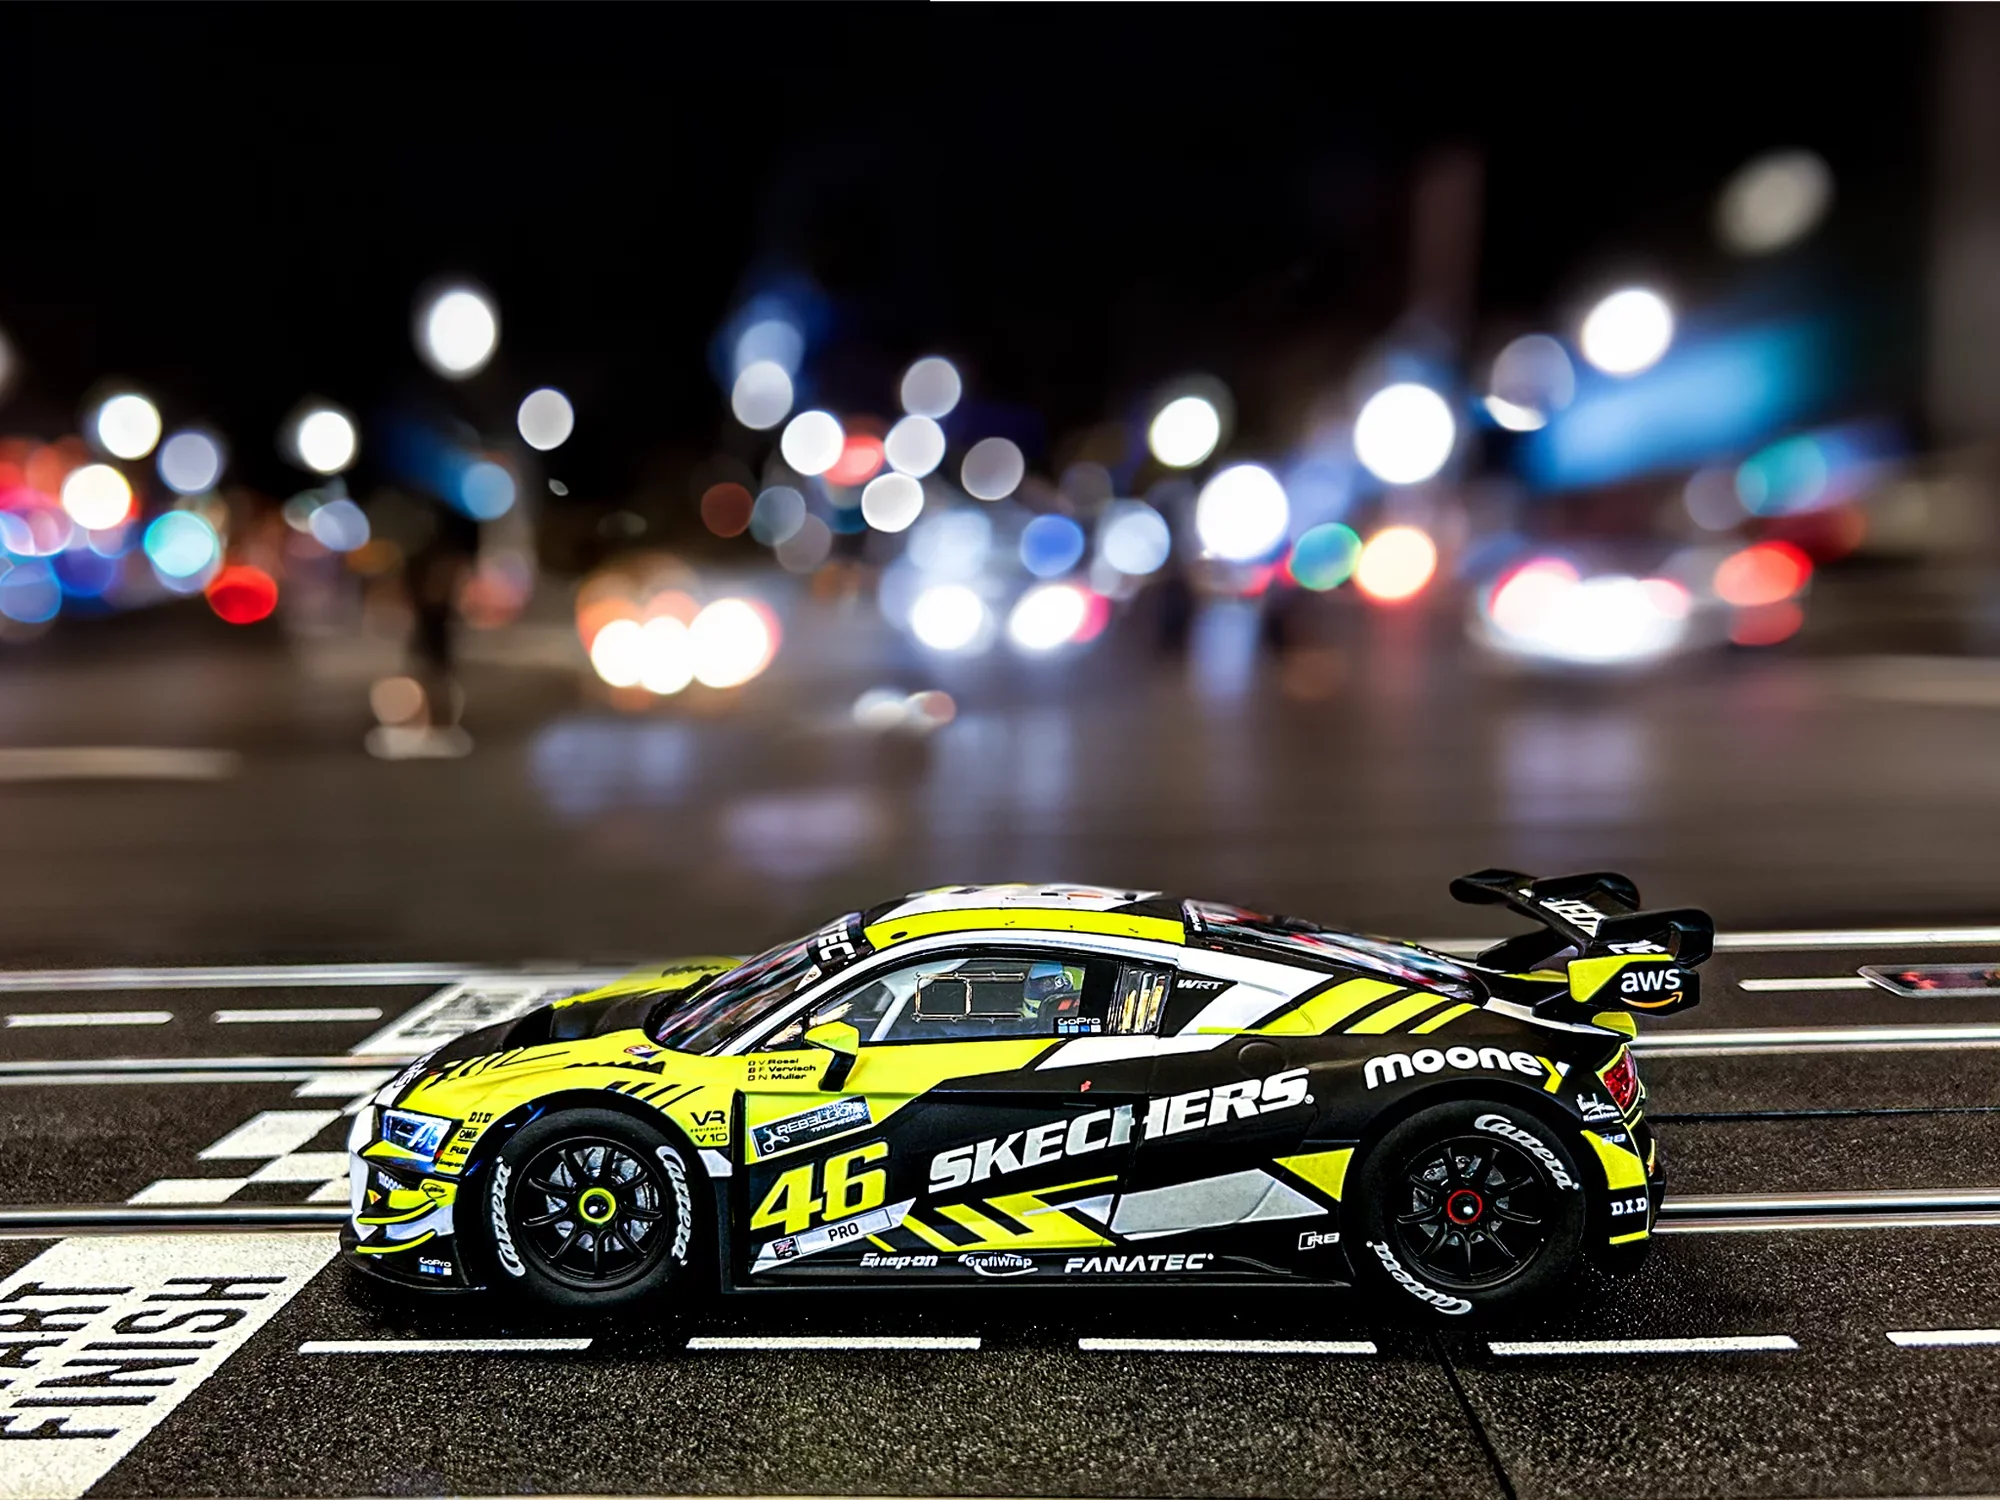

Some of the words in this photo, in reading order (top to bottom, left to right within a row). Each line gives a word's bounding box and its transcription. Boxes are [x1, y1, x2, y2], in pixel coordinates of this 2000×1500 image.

[1177, 979, 1224, 990] WRT
[1621, 968, 1681, 992] aws
[1057, 1017, 1101, 1026] GoPro
[1364, 1046, 1571, 1094] mooney
[690, 1110, 726, 1126] VR
[1474, 1114, 1581, 1190] Carrera
[656, 1146, 692, 1265] Carrera
[750, 1141, 889, 1235] 46
[491, 1157, 526, 1277] Carrera
[828, 1222, 860, 1241] PRO
[419, 1256, 452, 1268] GoPro
[1064, 1253, 1214, 1273] FANATEC
[1366, 1240, 1472, 1315] Carrera
[0, 1276, 288, 1440] FINISH
